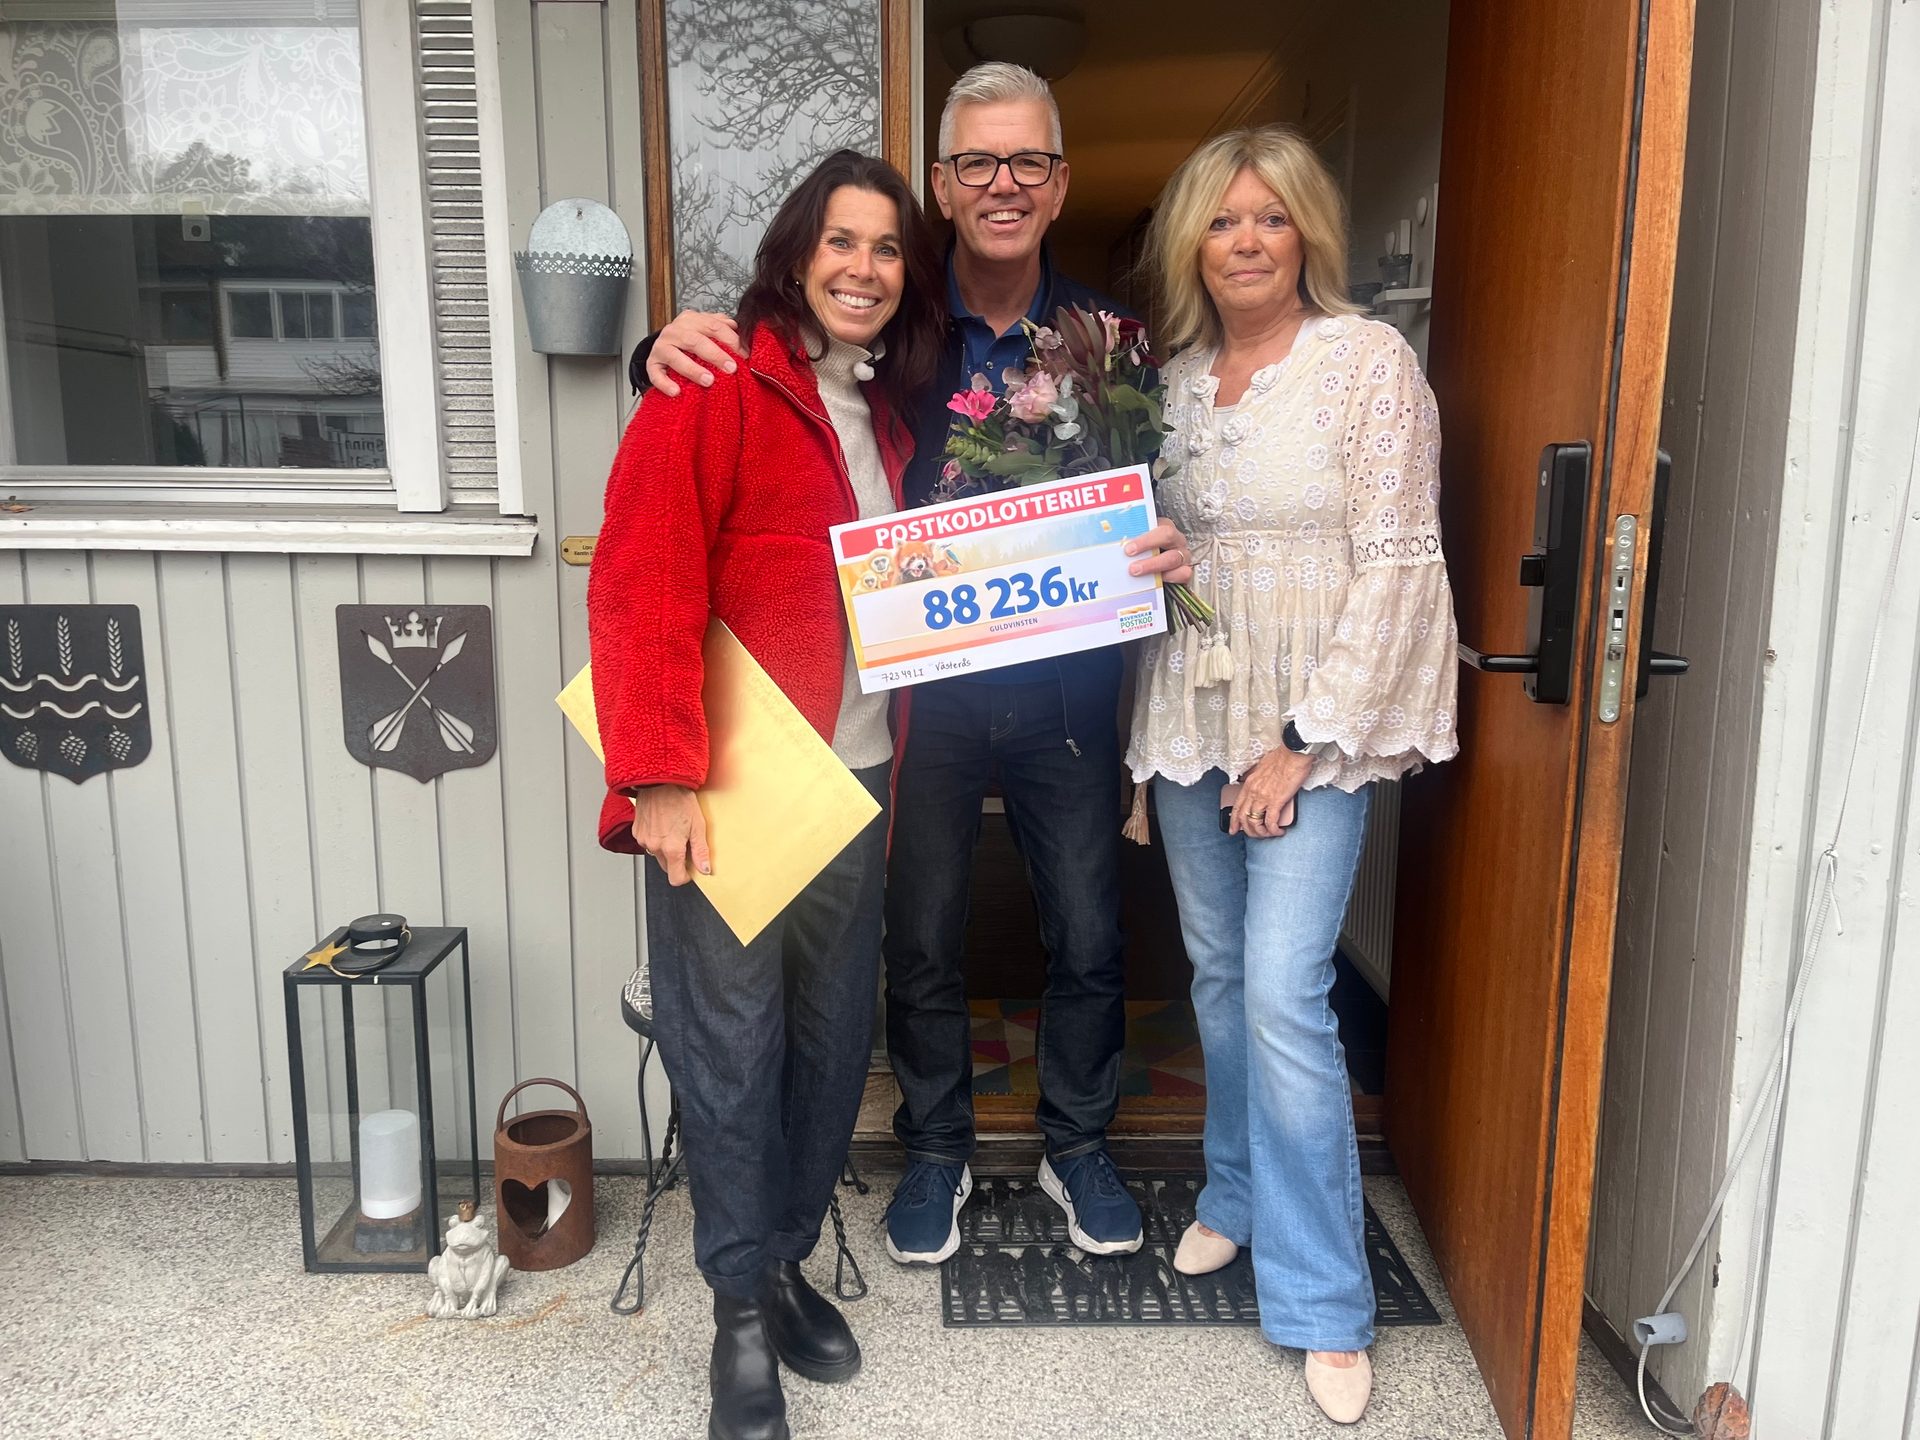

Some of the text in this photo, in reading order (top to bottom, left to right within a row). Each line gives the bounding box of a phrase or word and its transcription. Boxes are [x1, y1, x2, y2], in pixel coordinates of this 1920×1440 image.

[875, 483, 1108, 547] POSTKODLOTTERIET
[922, 584, 981, 630] 88
[1120, 616, 1153, 629] POSTKOD
[1123, 612, 1148, 621] SVENSKA
[989, 617, 1039, 632] GULDVINSTEN
[935, 657, 971, 672] Västerås
